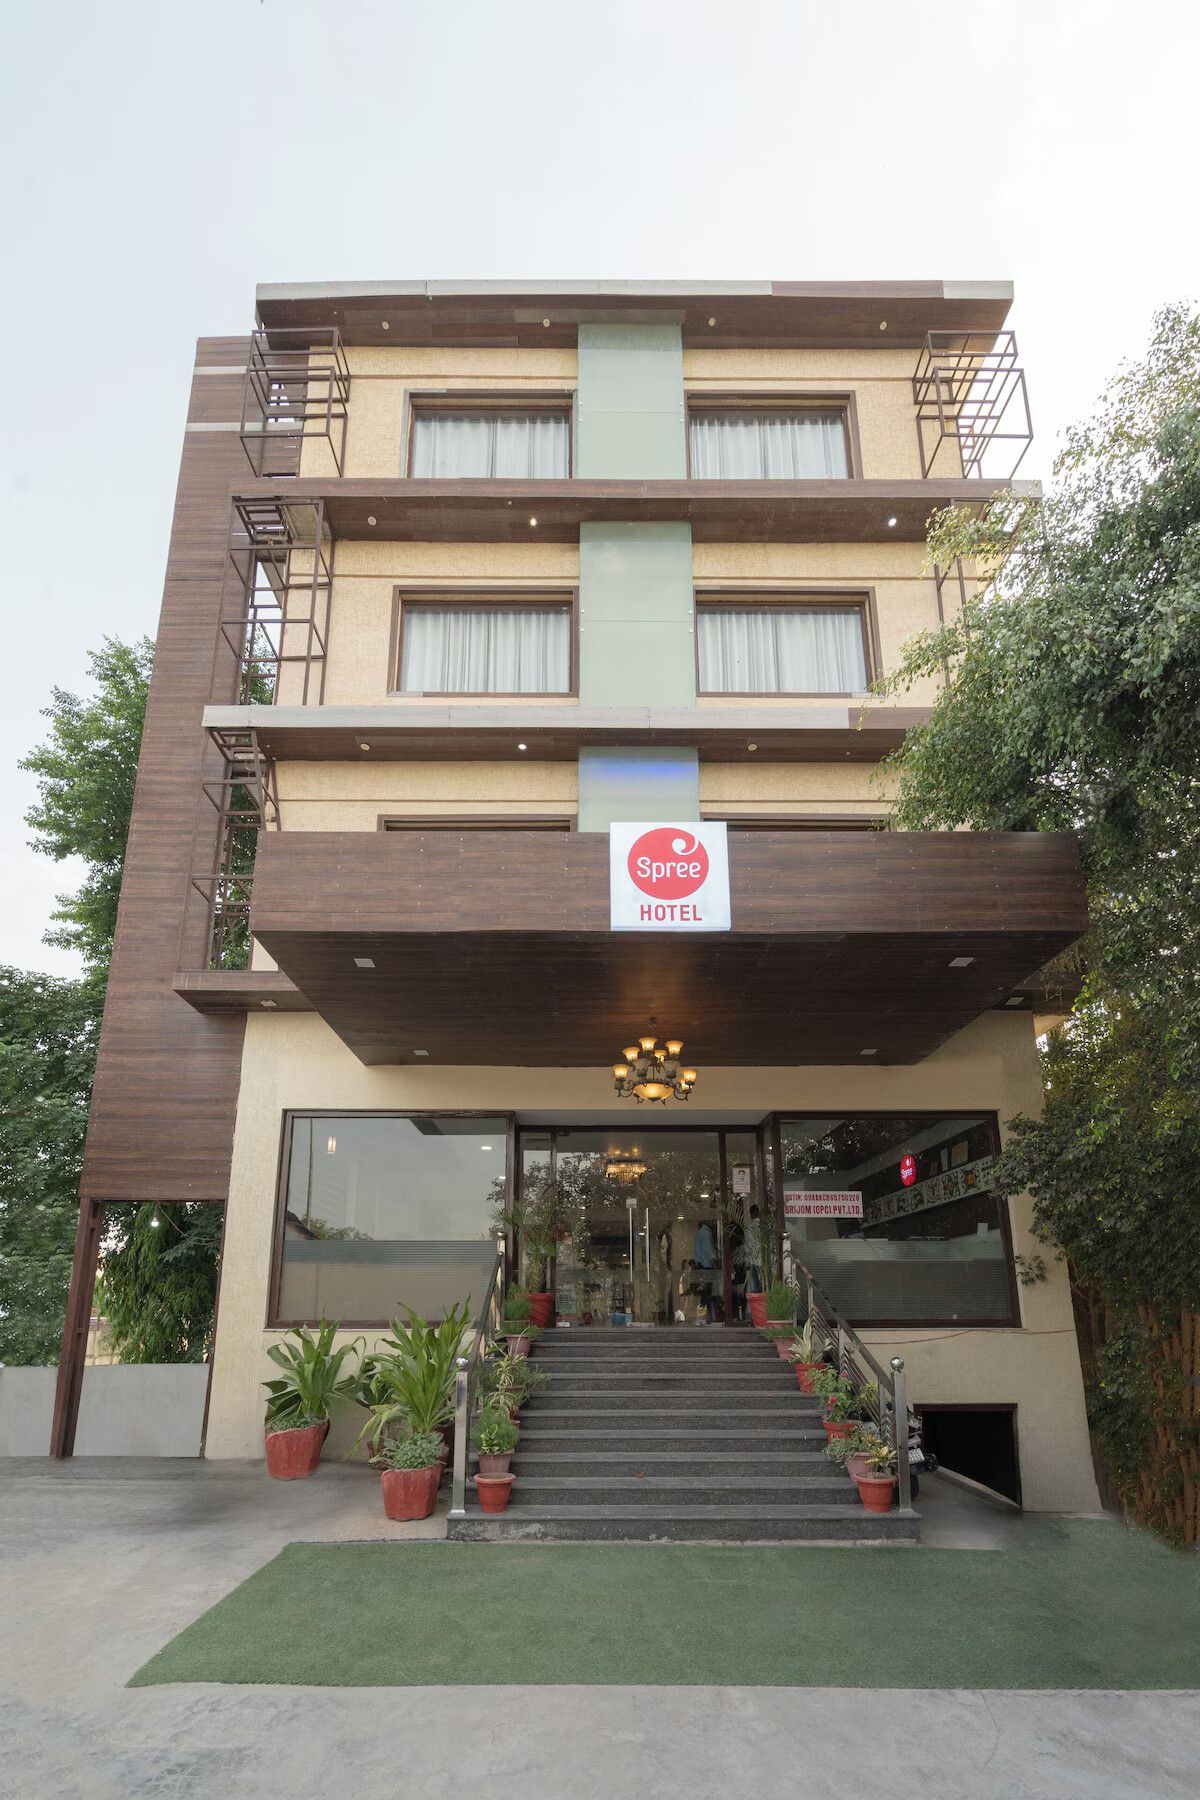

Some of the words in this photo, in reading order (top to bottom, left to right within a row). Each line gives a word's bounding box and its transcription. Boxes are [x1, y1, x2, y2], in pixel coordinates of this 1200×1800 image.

[636, 856, 702, 883] Spree
[639, 904, 703, 921] HOTEL
[785, 1205, 812, 1215] BRIJOM
[813, 1205, 832, 1215] (OPC)
